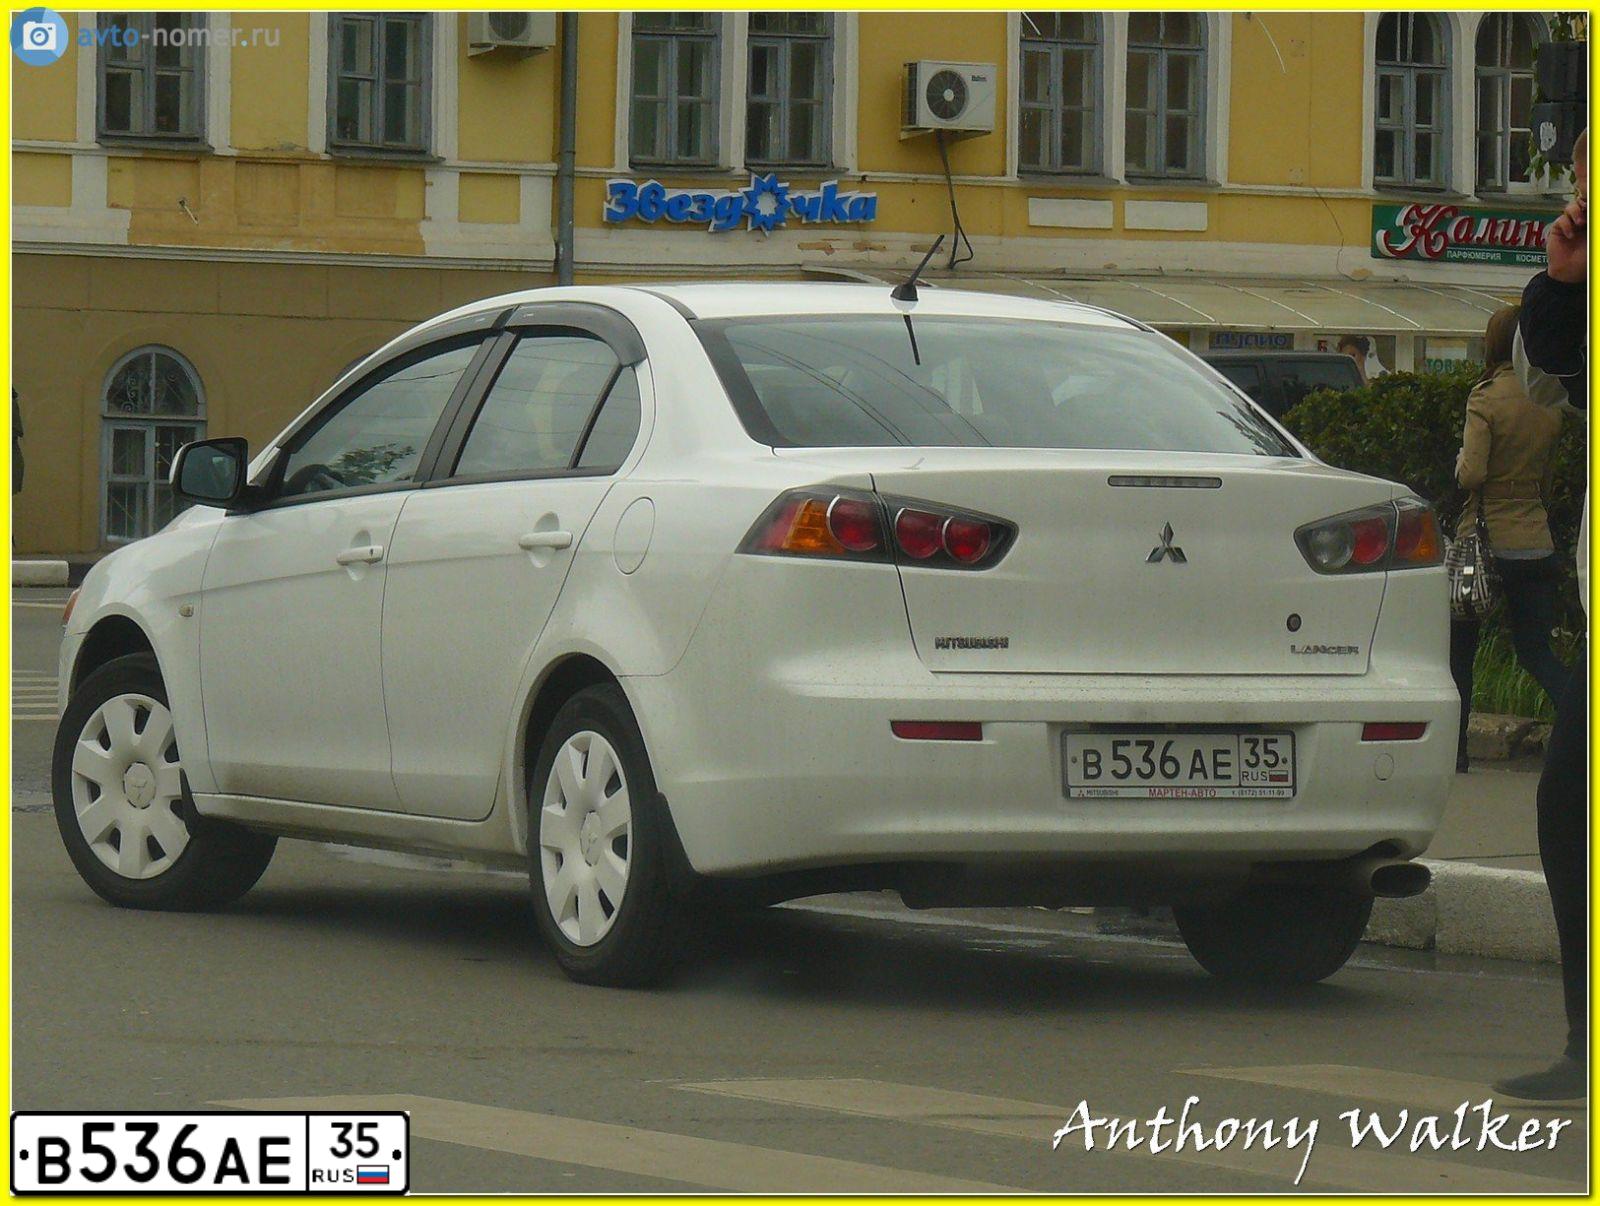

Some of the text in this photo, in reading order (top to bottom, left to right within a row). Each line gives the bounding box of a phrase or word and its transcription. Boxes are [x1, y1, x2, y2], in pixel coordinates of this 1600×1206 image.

[1376, 203, 1551, 259] Калин
[1446, 249, 1549, 263] ПАРФЮМЕРИЯ КОСМЕТ
[934, 636, 1009, 649] MITSUBISHI
[1290, 644, 1359, 655] LANCER
[1243, 737, 1280, 769] 35
[1241, 771, 1268, 782] RUS
[1148, 788, 1217, 798] МАРТЕН-АВТО
